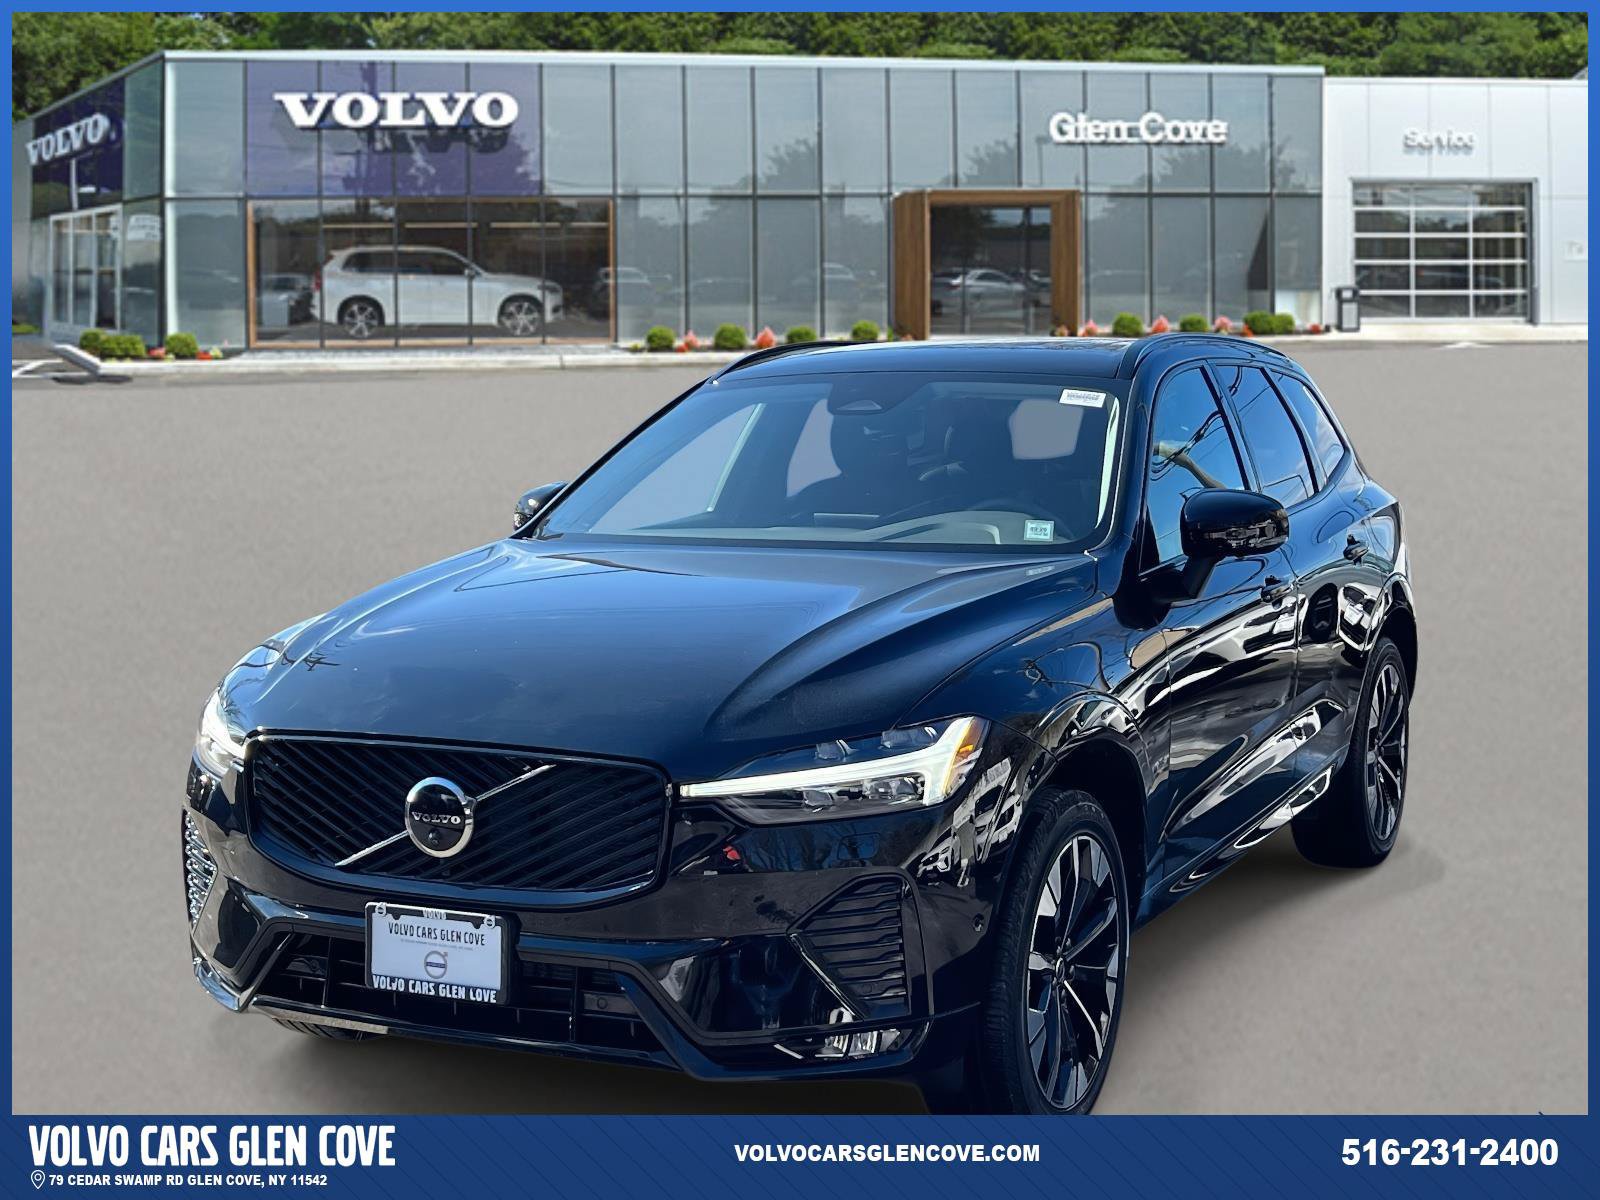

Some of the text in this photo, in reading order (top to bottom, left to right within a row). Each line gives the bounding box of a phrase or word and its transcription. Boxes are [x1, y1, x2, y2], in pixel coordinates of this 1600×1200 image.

[273, 91, 519, 128] VOLVO
[25, 112, 111, 166] VOLVO
[1049, 111, 1228, 143] Glen Cove
[411, 811, 461, 825] VOLVO
[388, 922, 414, 937] VOLVO
[416, 926, 438, 940] CARS
[440, 929, 462, 943] GLEN
[464, 932, 486, 946] COVE
[408, 980, 436, 996] CARS
[438, 984, 466, 1000] GLEN
